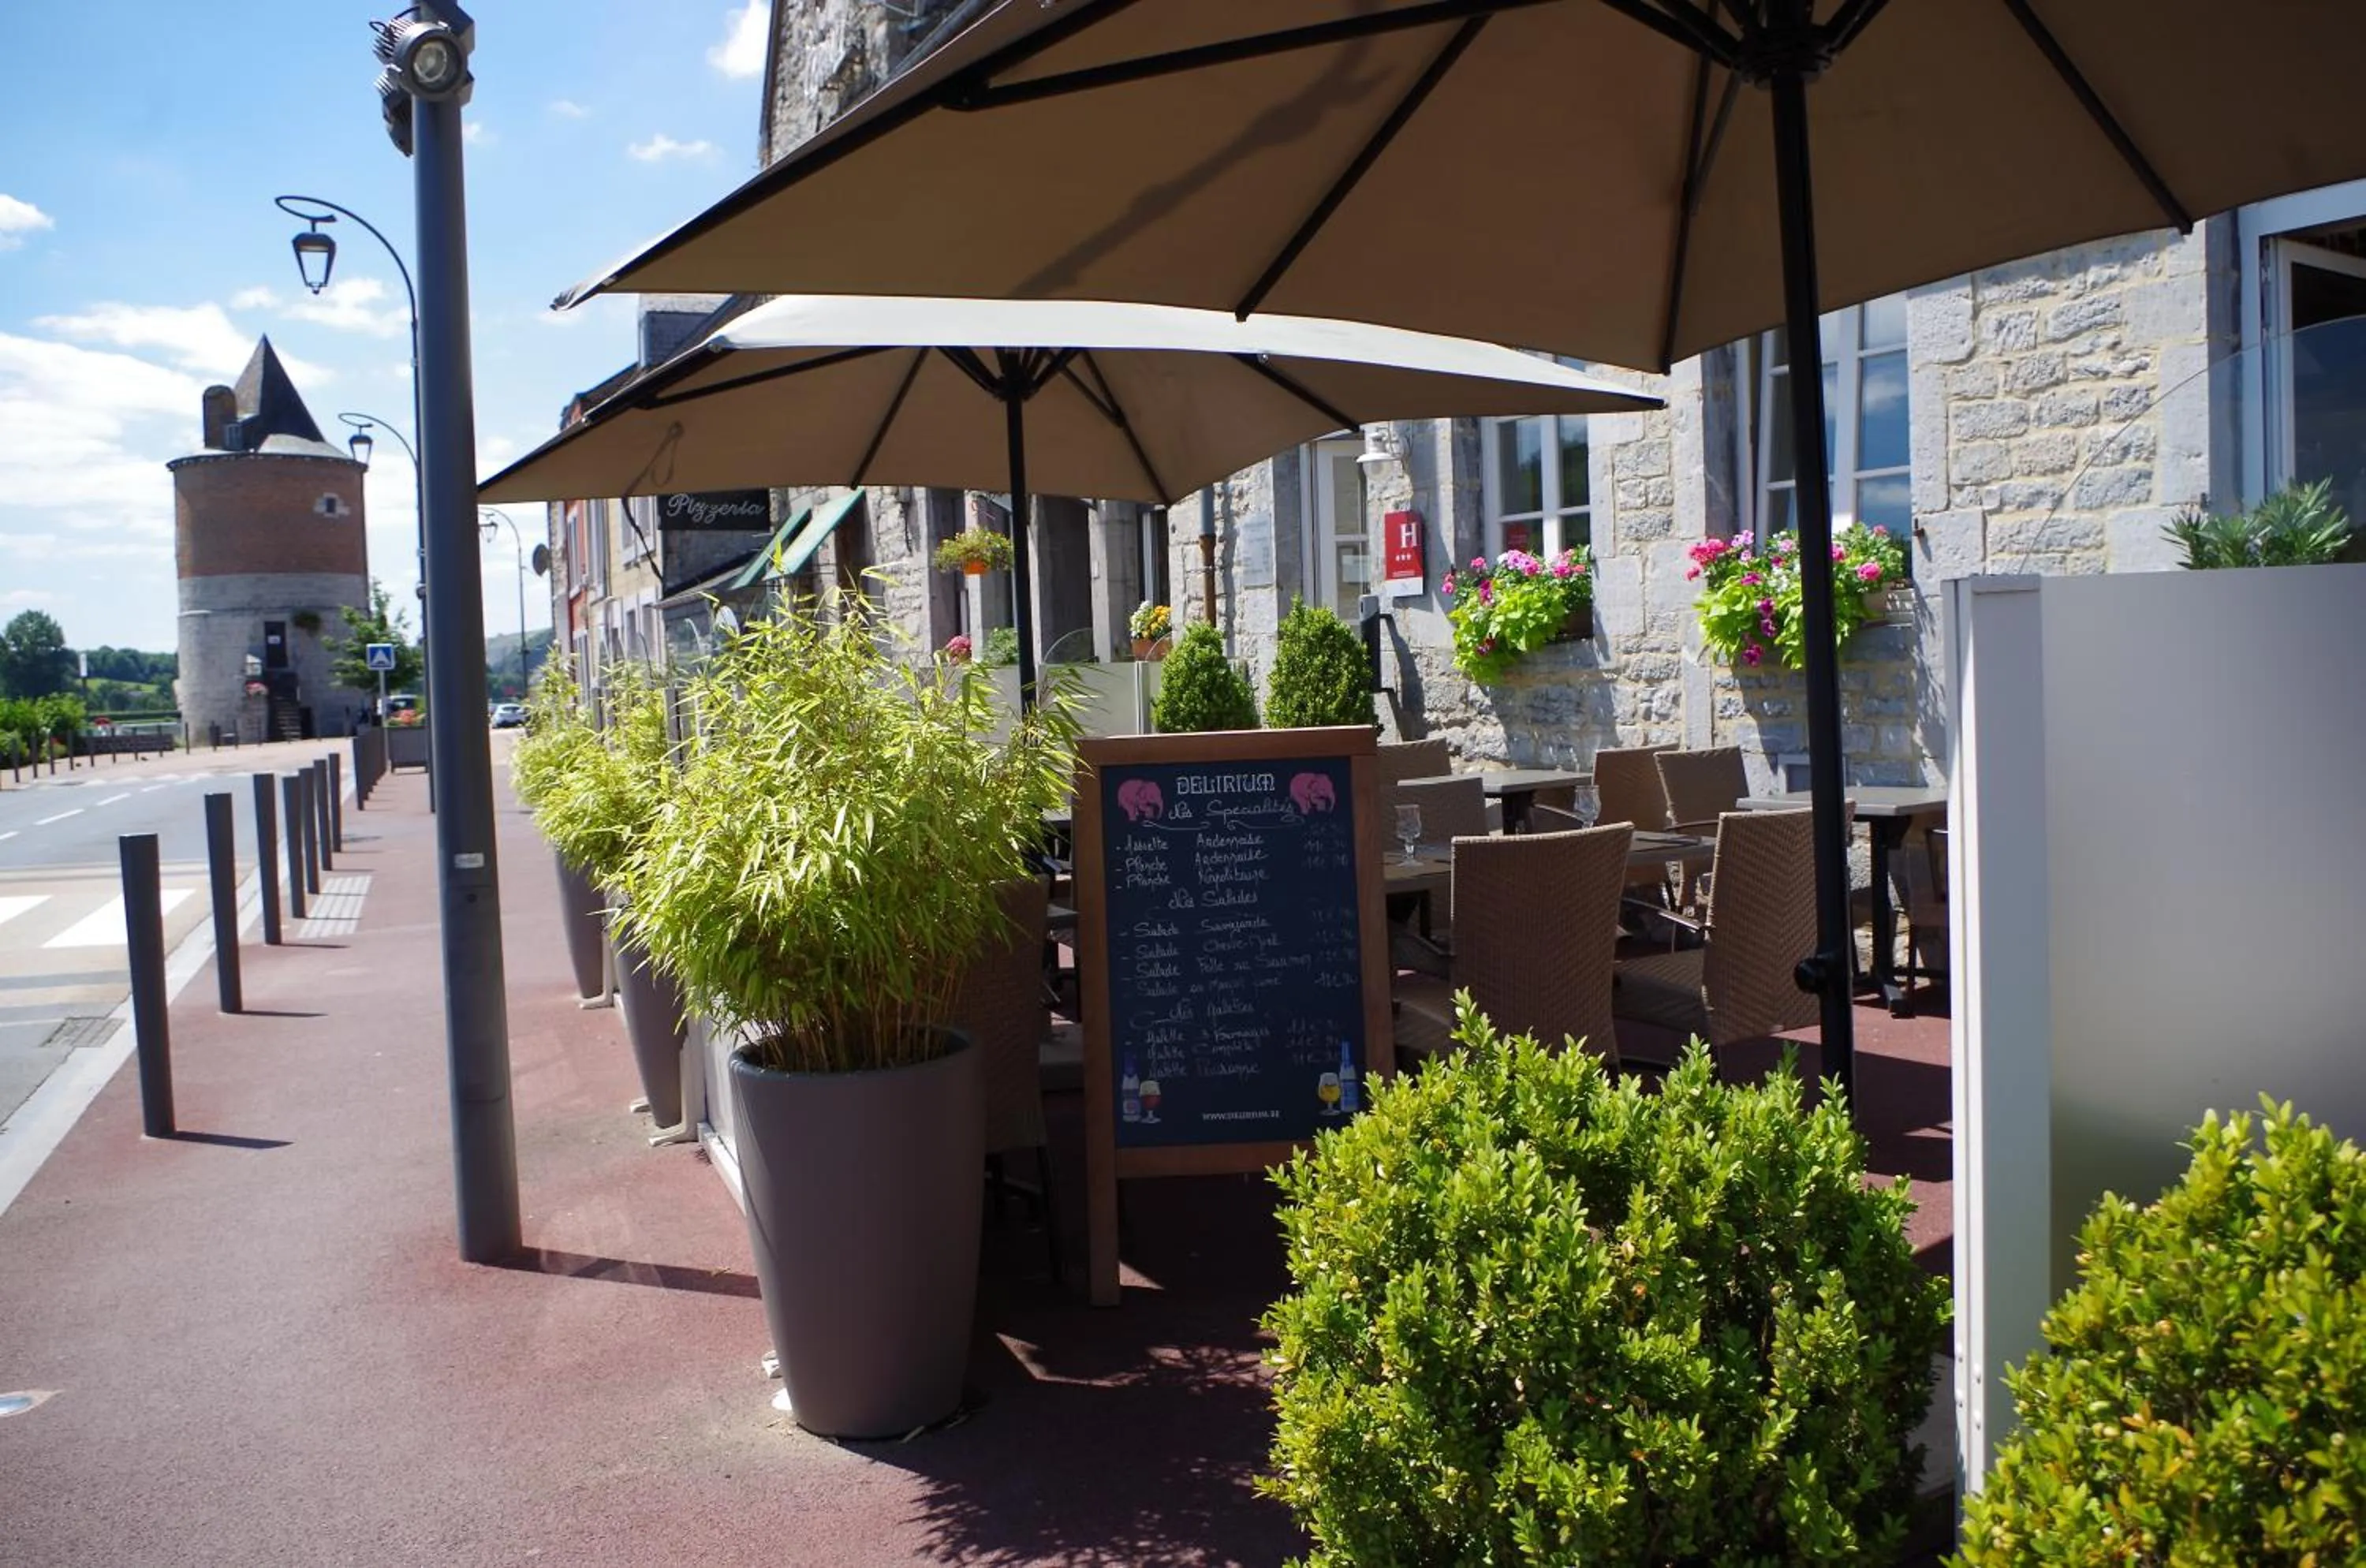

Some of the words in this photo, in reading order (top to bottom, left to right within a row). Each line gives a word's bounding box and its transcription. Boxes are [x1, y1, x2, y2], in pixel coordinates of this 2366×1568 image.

[667, 494, 765, 523] Pizzeria
[1400, 522, 1418, 548] H
[1176, 774, 1275, 795] DELIRIUM
